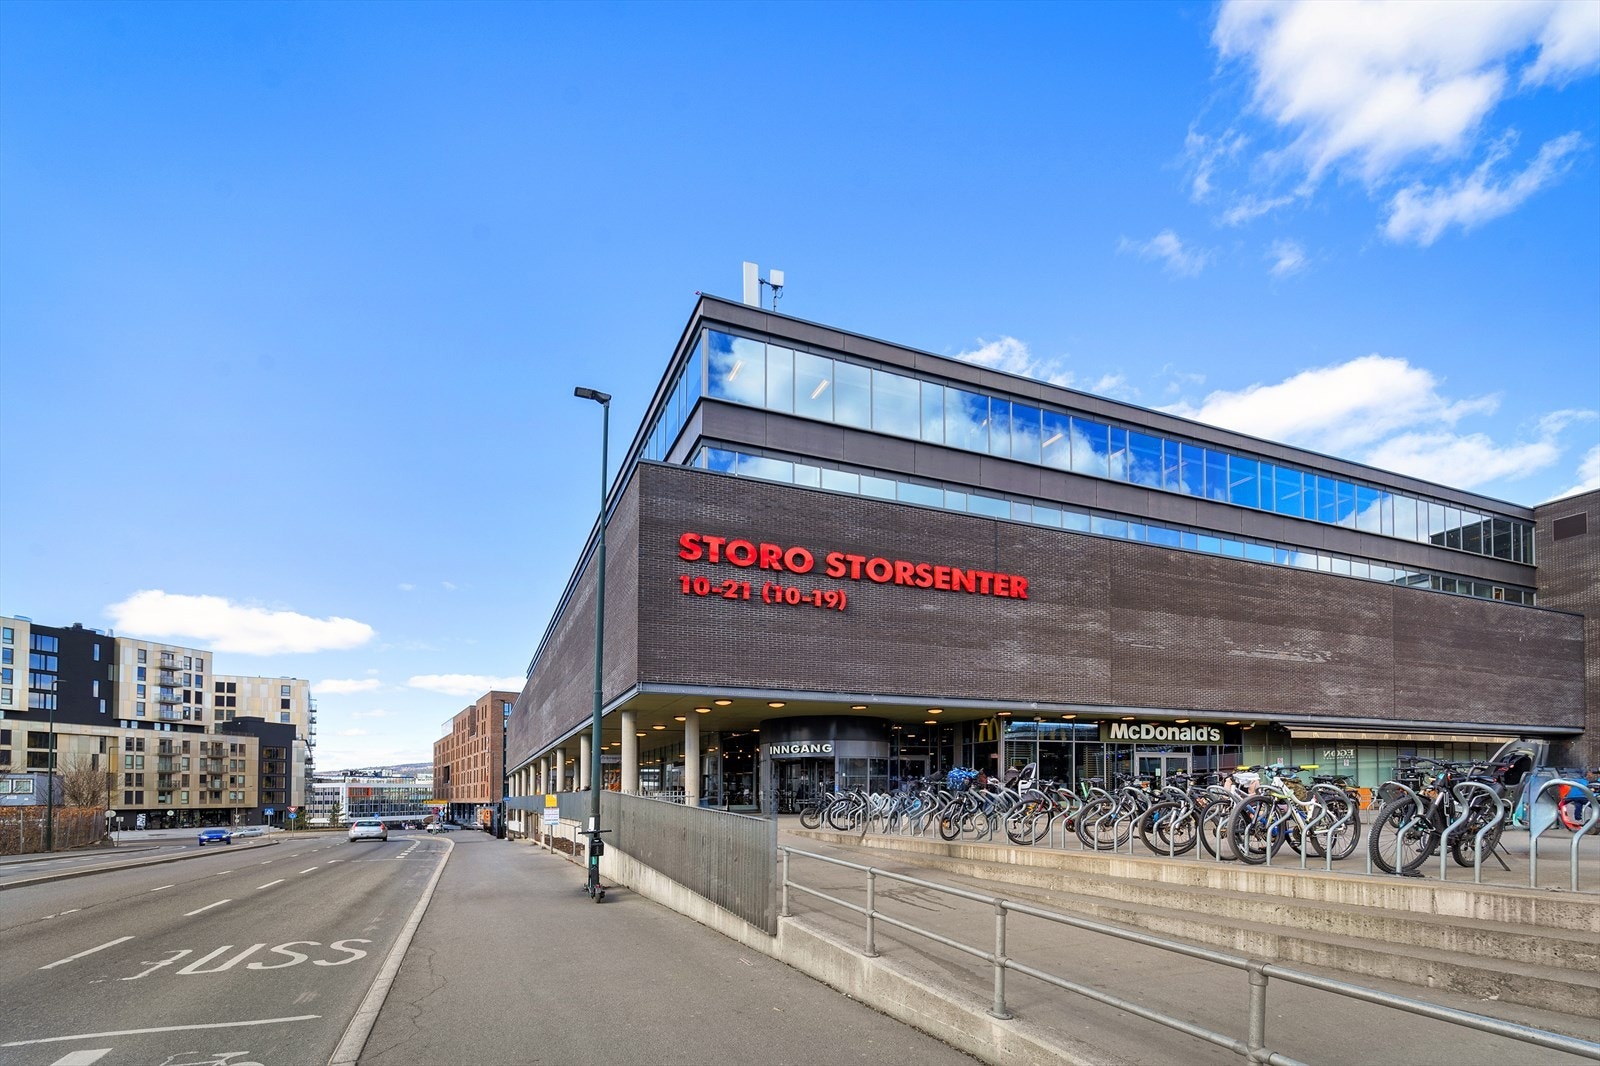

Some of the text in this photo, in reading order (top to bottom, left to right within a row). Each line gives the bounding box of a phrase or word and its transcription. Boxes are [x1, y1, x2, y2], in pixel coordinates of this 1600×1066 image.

[678, 532, 1029, 600] STORO STORSENTER
[679, 575, 847, 611] 10-21 (10-19)
[1110, 722, 1221, 742] McDonald's
[769, 743, 833, 755] INNGANG
